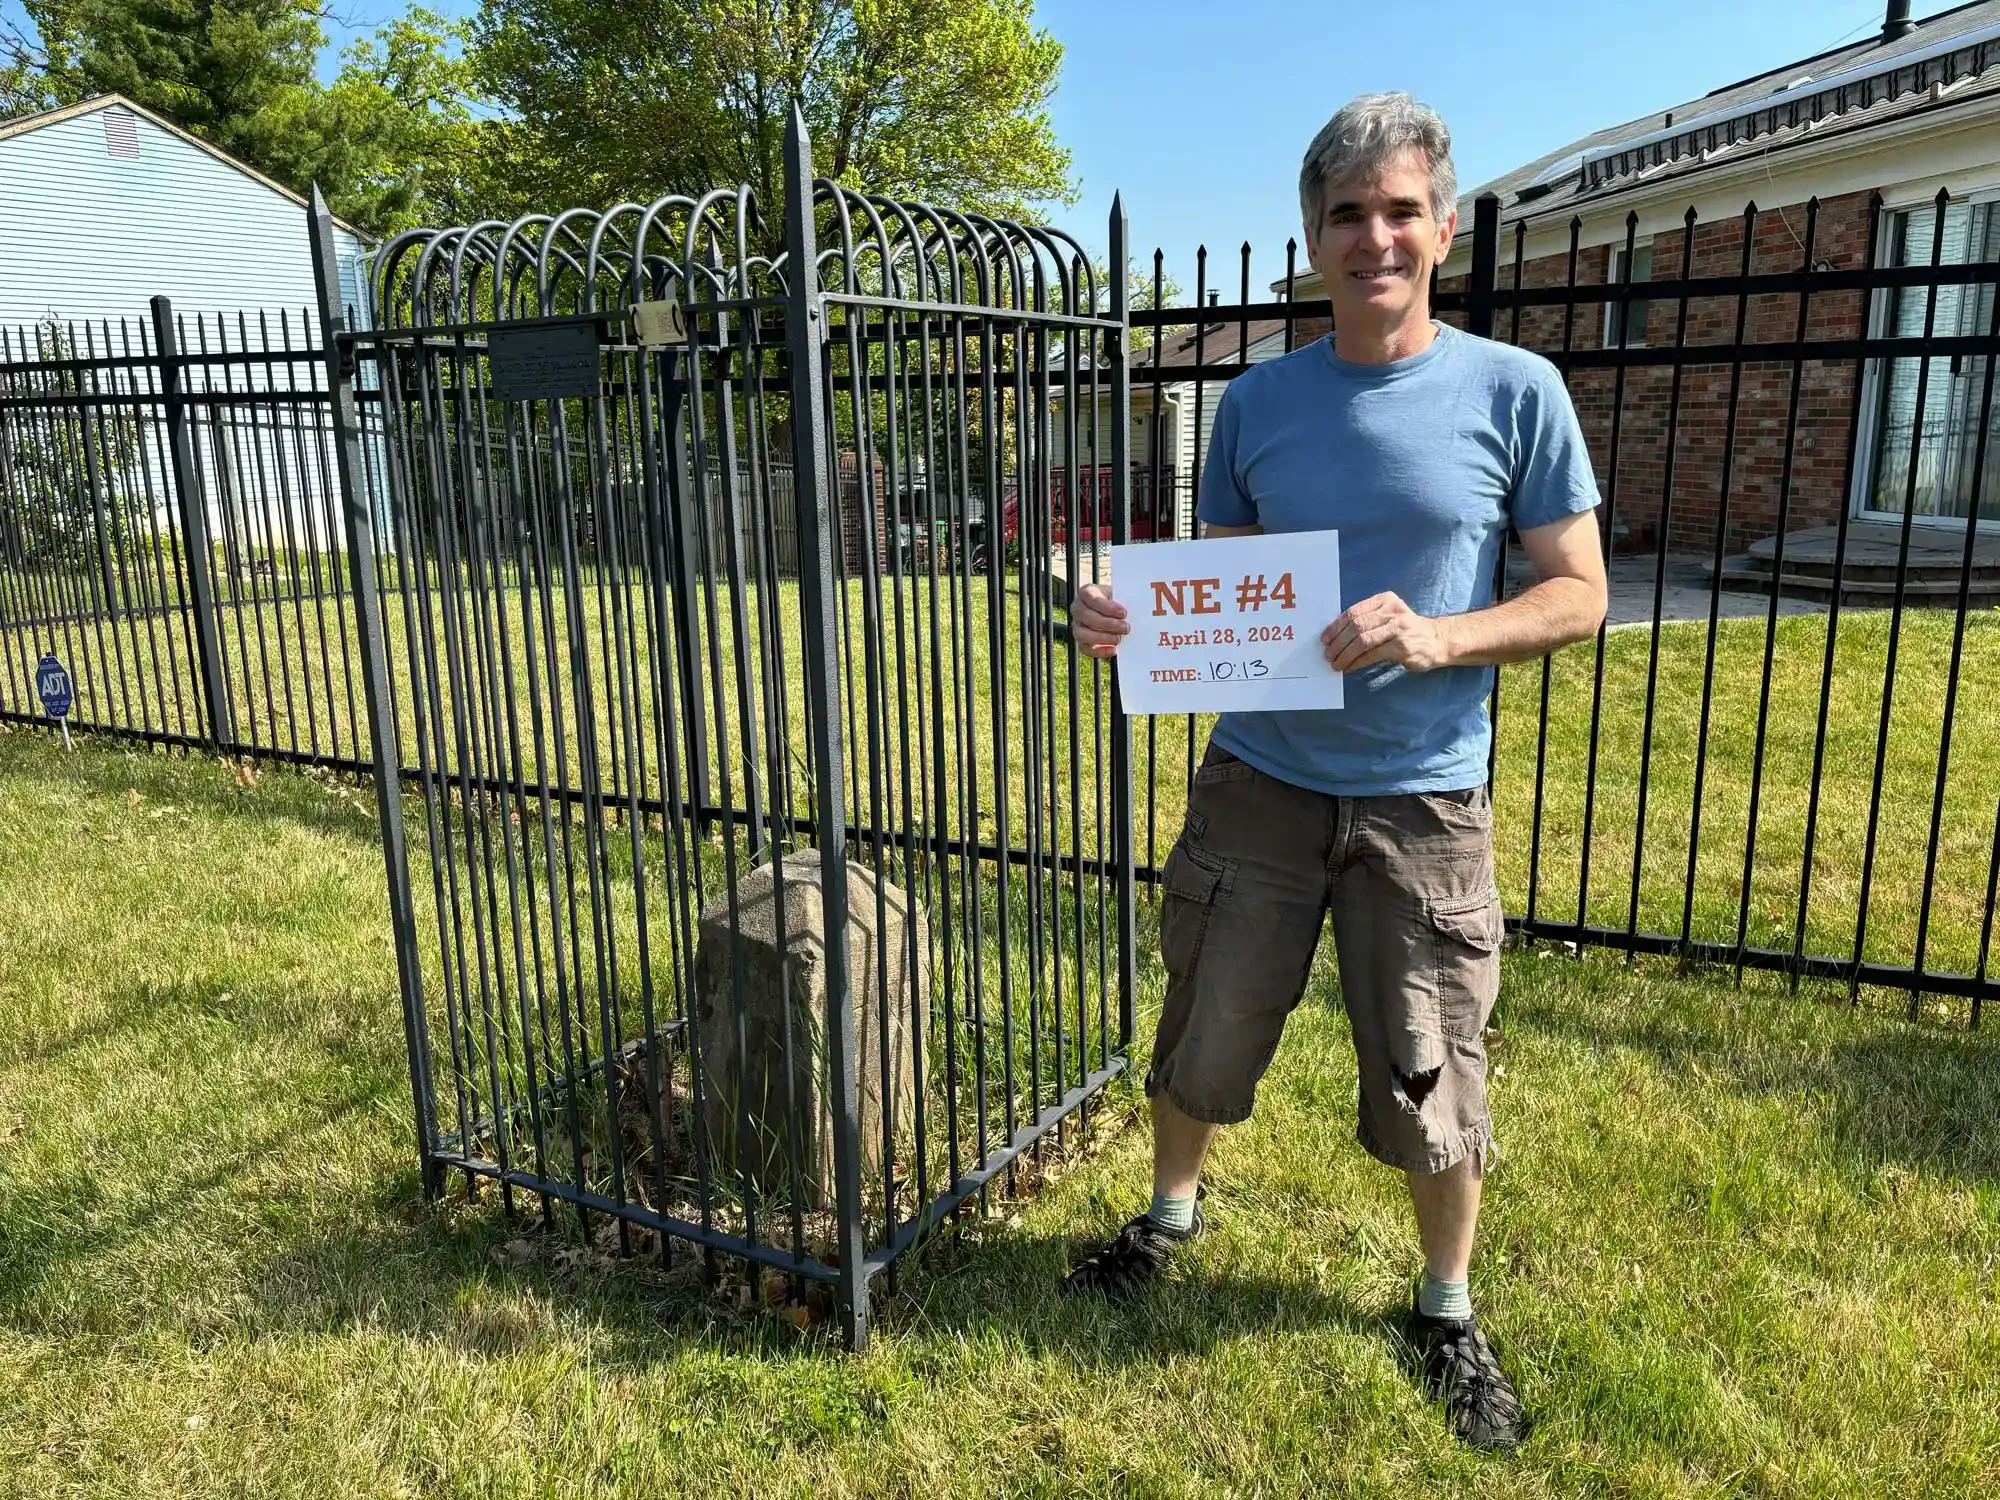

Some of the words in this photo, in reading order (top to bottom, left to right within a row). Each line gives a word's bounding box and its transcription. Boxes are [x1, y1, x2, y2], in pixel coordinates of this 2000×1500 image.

[1150, 578, 1221, 616] NE
[1235, 572, 1296, 613] #4
[1158, 630, 1208, 650] April
[1212, 628, 1241, 646] 28,
[1248, 625, 1294, 643] 2024
[1150, 668, 1202, 683] TIME:
[1209, 659, 1269, 681] 10:13
[42, 672, 66, 697] ADT
